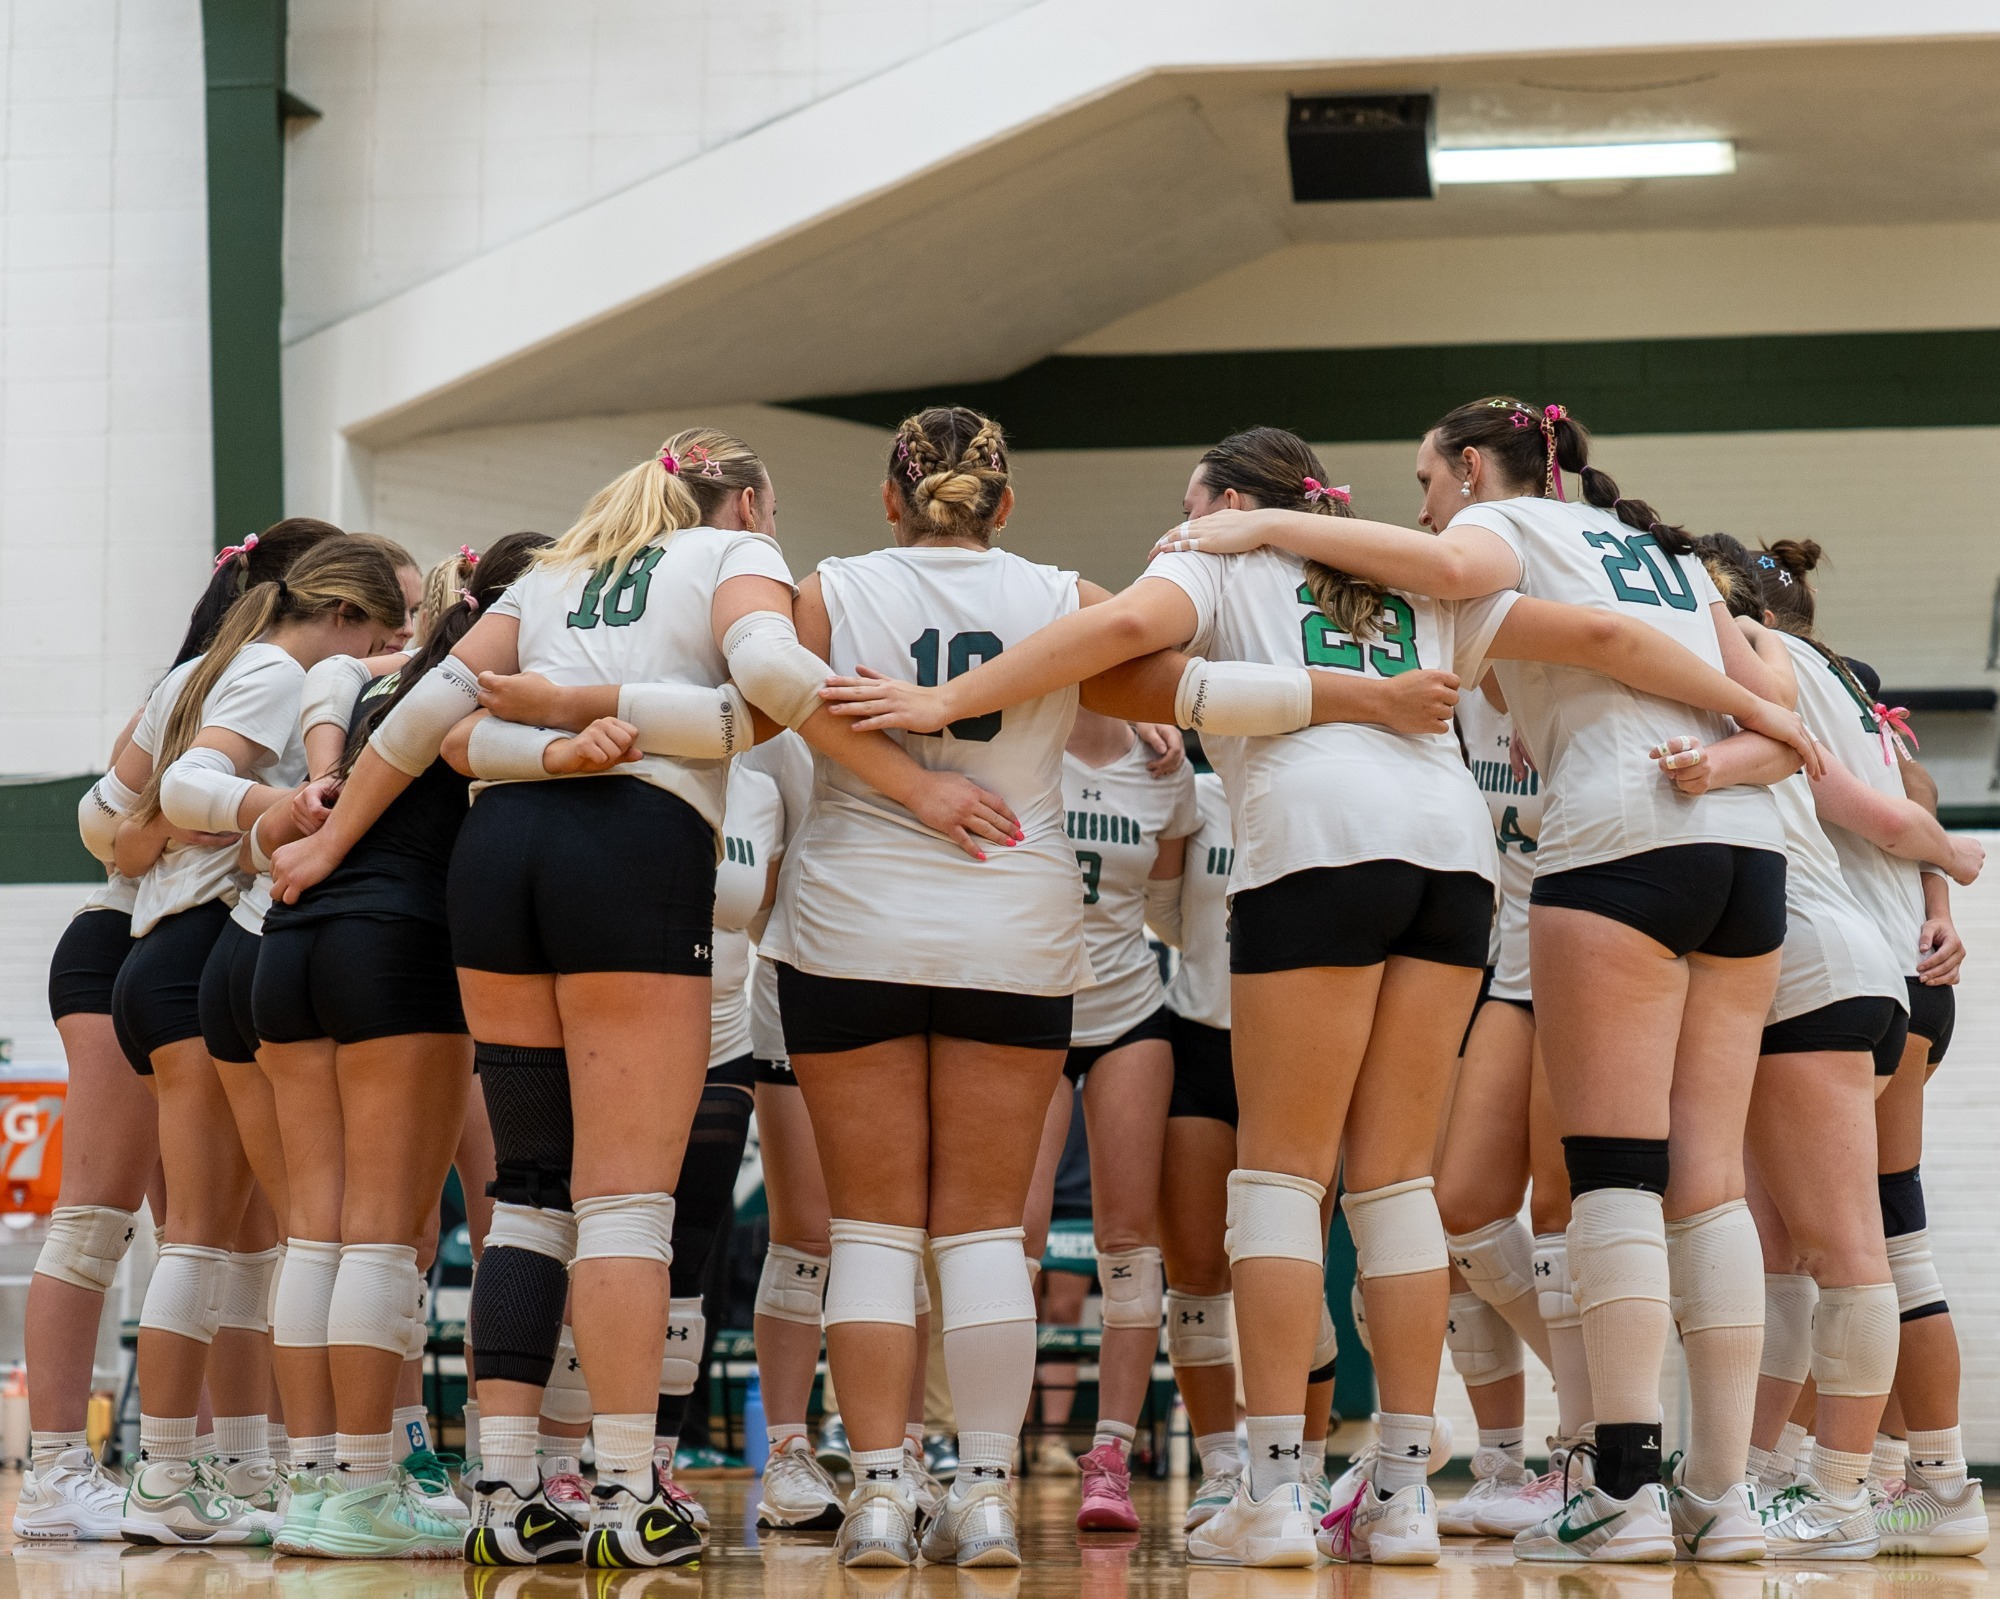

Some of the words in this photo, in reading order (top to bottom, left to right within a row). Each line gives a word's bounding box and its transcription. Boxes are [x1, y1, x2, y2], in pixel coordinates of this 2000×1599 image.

[567, 546, 667, 629] 18
[1582, 531, 1698, 612] 20
[1296, 580, 1423, 678] 23
[4, 1102, 39, 1143] G
